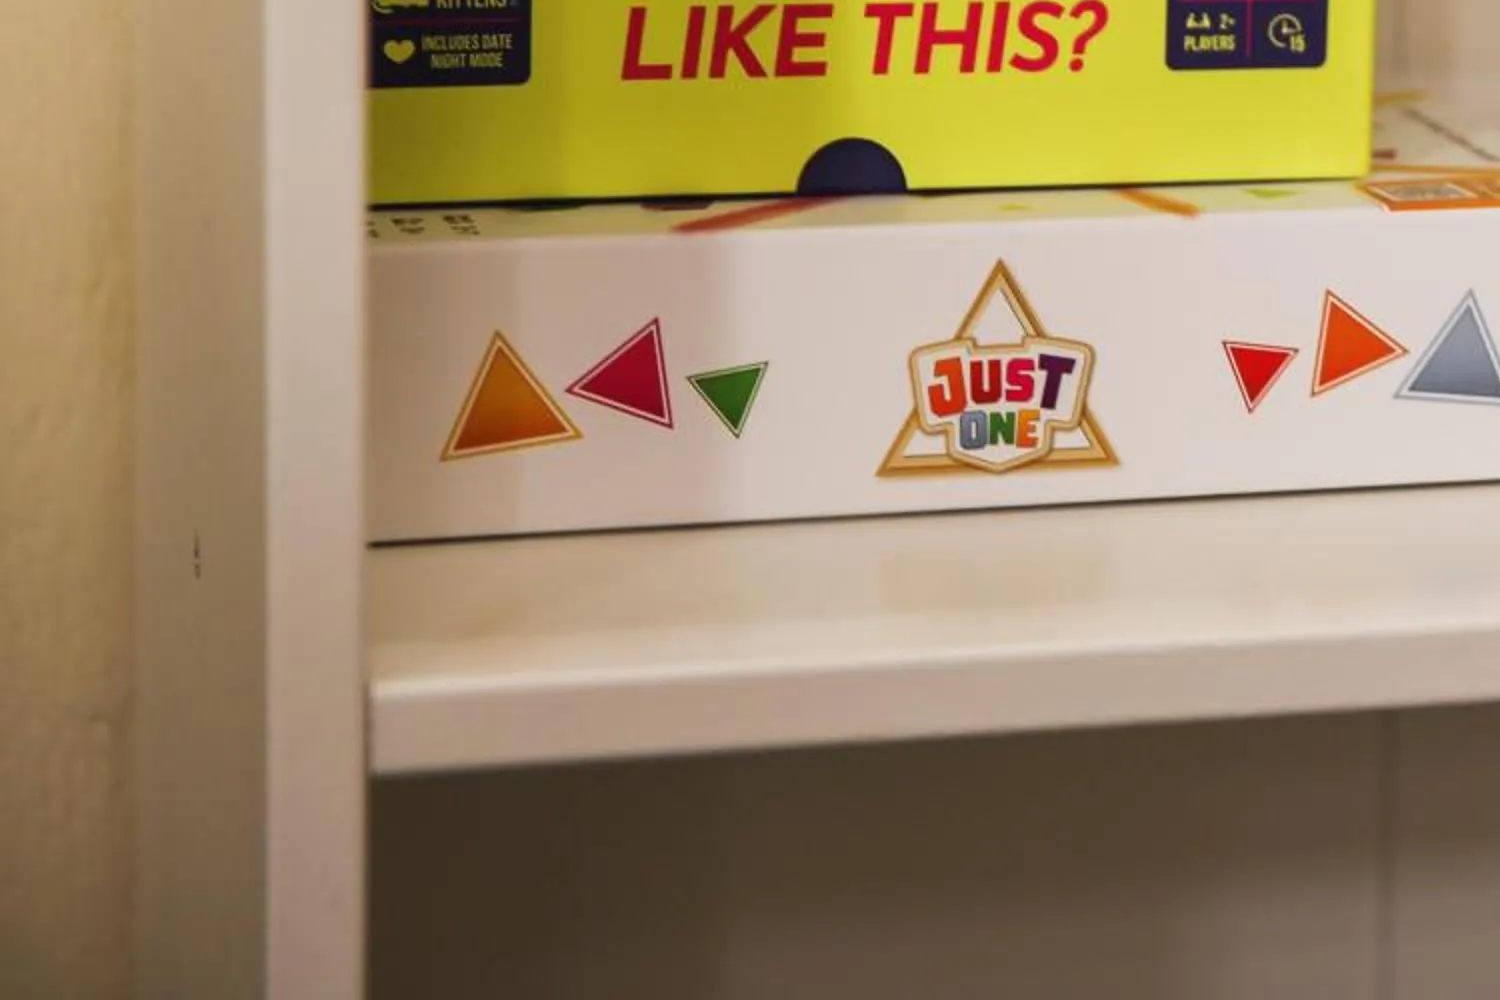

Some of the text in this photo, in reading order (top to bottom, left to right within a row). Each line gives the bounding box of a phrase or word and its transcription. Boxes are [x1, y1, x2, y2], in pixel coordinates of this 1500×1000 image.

[421, 33, 513, 50] INCLUDES DATE
[621, 3, 834, 80] LIKE
[1183, 34, 1236, 53] PLAYERS
[431, 51, 503, 69] NIGHT MODE
[927, 353, 1076, 418] JUST
[959, 408, 1041, 450] ONE
